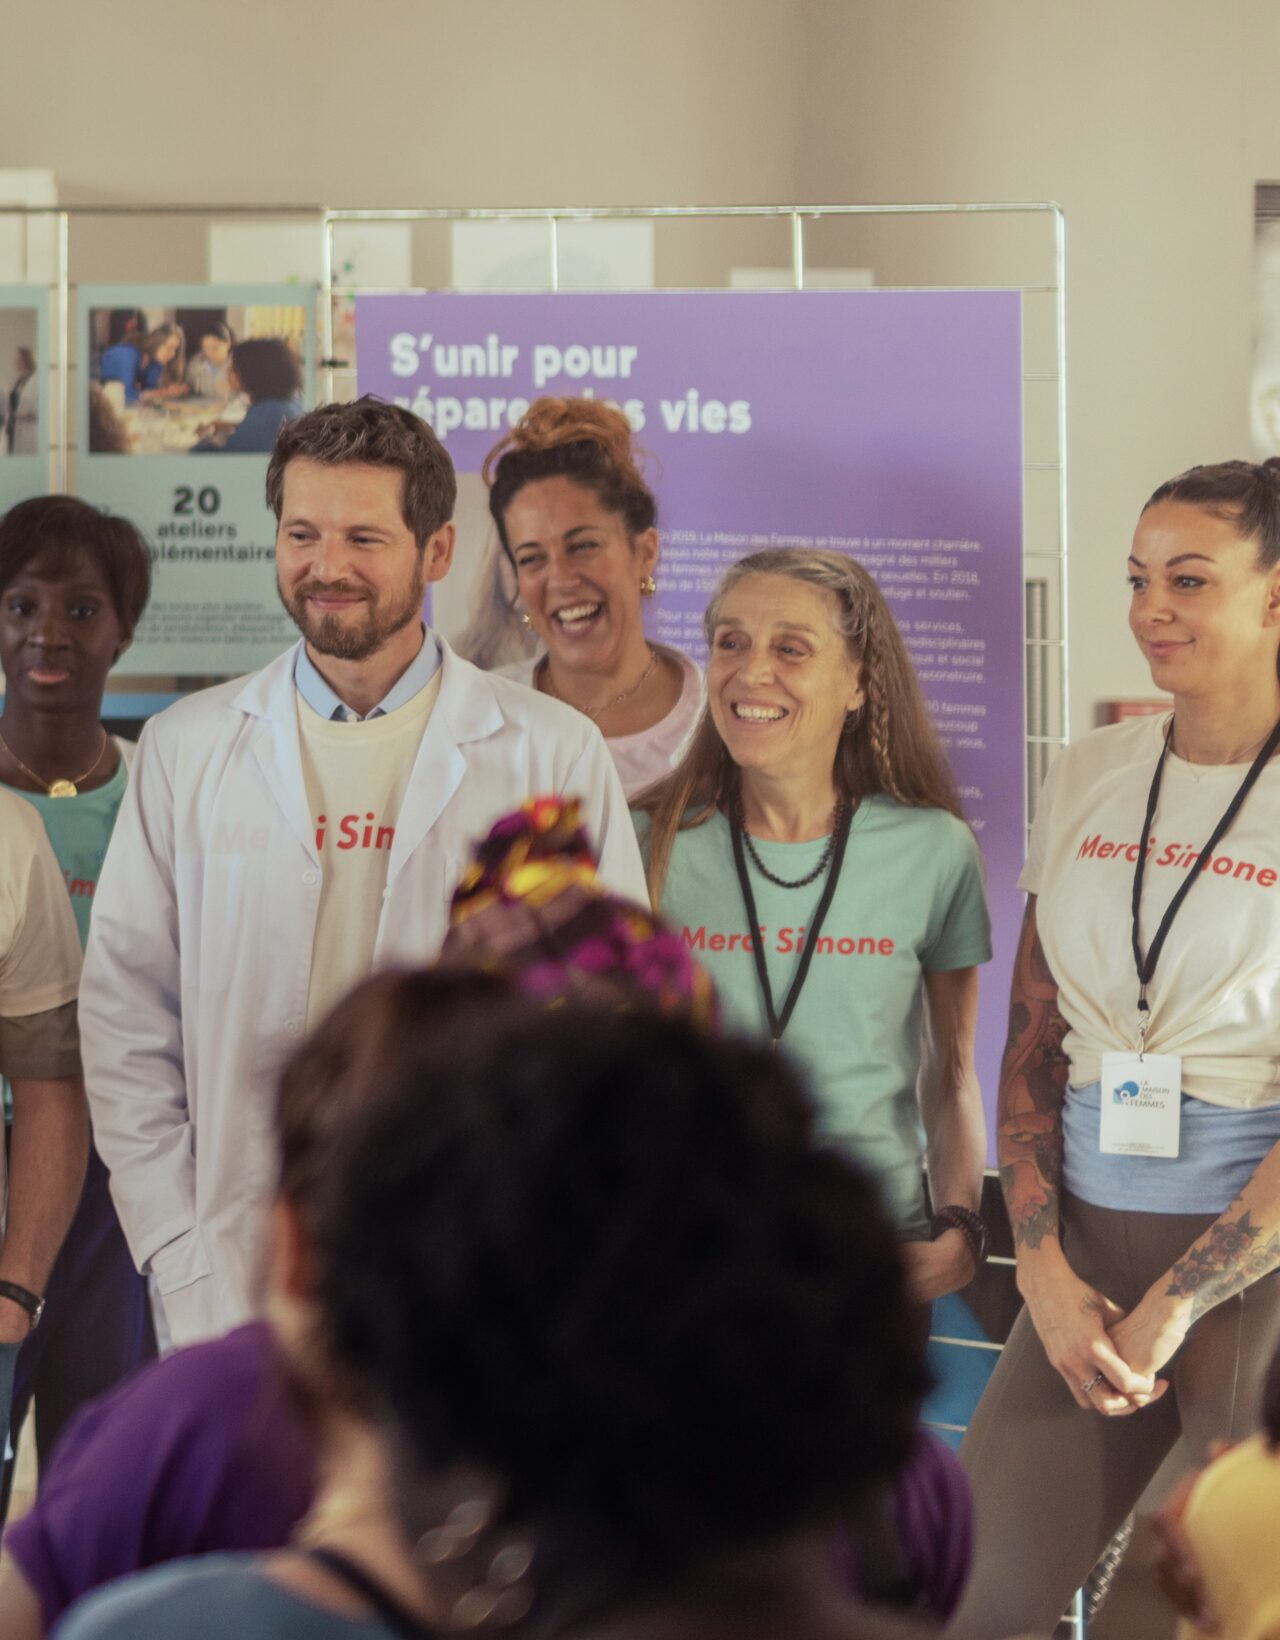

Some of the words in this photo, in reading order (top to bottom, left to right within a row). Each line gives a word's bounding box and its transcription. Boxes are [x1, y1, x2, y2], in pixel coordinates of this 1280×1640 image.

[534, 344, 638, 388] pour
[659, 387, 752, 434] vies
[172, 485, 223, 516] 20
[157, 521, 238, 538] ateliers
[952, 654, 985, 668] social
[1075, 833, 1157, 863] Merci
[681, 925, 767, 953] Merci
[775, 926, 895, 957] Simone
[1130, 1100, 1166, 1109] FEMMES
